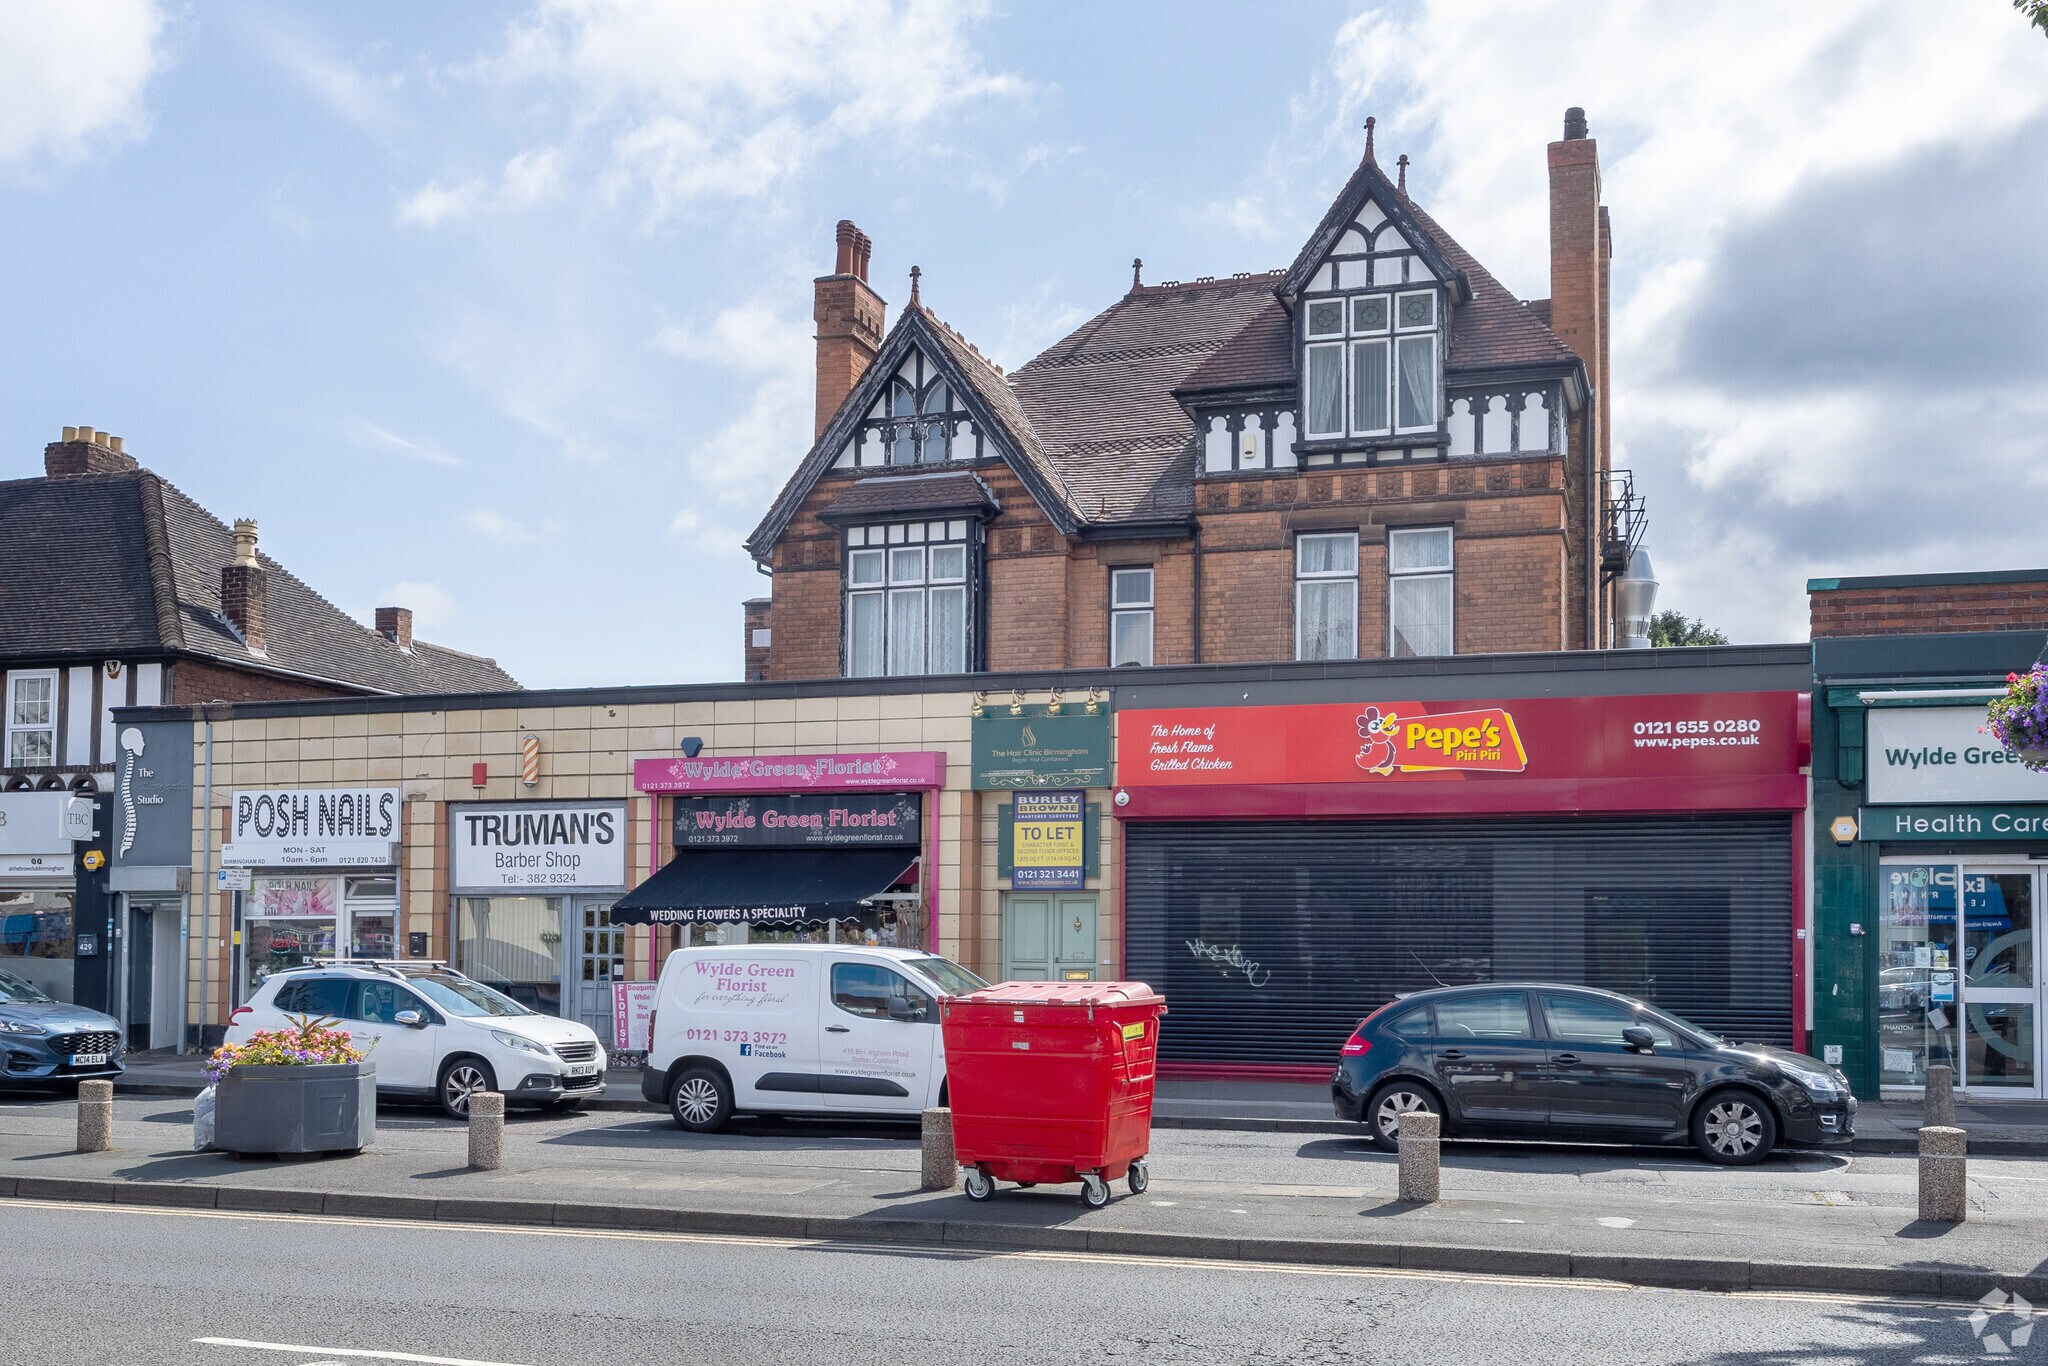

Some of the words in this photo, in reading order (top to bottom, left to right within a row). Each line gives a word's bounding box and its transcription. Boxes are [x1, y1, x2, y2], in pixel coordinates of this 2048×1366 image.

[1151, 724, 1168, 736] The
[1171, 724, 1201, 736] Home
[1204, 723, 1216, 740] of
[1634, 722, 1672, 734] 0121
[1676, 720, 1709, 734] 655
[1713, 719, 1761, 732] 0280
[1406, 718, 1501, 756] Pepe's
[1634, 734, 1760, 750] www.pepes.co.uk
[1044, 748, 1088, 757] Birmingham
[1150, 741, 1179, 754] Fresh
[1181, 741, 1214, 753] Flame
[1456, 750, 1477, 761] Piri
[1480, 749, 1501, 760] Piri
[1885, 747, 1956, 769] Wylde
[1964, 747, 2024, 764] Gree
[684, 761, 742, 780] Wylde
[751, 760, 806, 776] Green
[816, 759, 881, 774] Florist
[1150, 758, 1190, 770] Grilled
[1191, 757, 1232, 769] Chicken
[138, 768, 154, 777] The
[138, 795, 164, 804] Studio
[68, 813, 88, 825] TBC
[238, 794, 308, 838] POSH
[319, 793, 394, 837] NAILS
[696, 811, 756, 832] Wylde
[762, 810, 822, 827] Green
[829, 809, 896, 826] Florist
[465, 812, 614, 846] TRUMAN'S
[1896, 814, 1981, 833] Health
[806, 834, 903, 842] www.wyldegreenflorist.co.uk
[1021, 827, 1041, 840] TO
[1047, 827, 1074, 839] LET
[310, 856, 328, 864] 6pm
[496, 852, 541, 868] Barber
[545, 852, 580, 870] Shop
[501, 874, 524, 883] Tel:-
[527, 874, 547, 883] 382
[550, 873, 576, 883] 9324
[268, 880, 292, 892] POSH
[294, 880, 319, 891] NAILS
[650, 910, 694, 921] WEDDING
[697, 909, 740, 920] FLOWERS
[743, 909, 749, 919] A
[751, 907, 806, 919] SPECIALITY
[695, 962, 742, 978] Wylde
[748, 964, 795, 977] Green
[716, 978, 767, 992] Florist
[694, 992, 708, 1005] for
[757, 993, 789, 1007] floral
[618, 984, 626, 1044] FLORIST
[687, 1029, 717, 1040] 0121
[724, 1031, 748, 1042] 373
[753, 1032, 787, 1044] 3972
[755, 1050, 786, 1058] Facebook
[835, 1069, 916, 1077] www.wyldegreenflorist.co.uk
